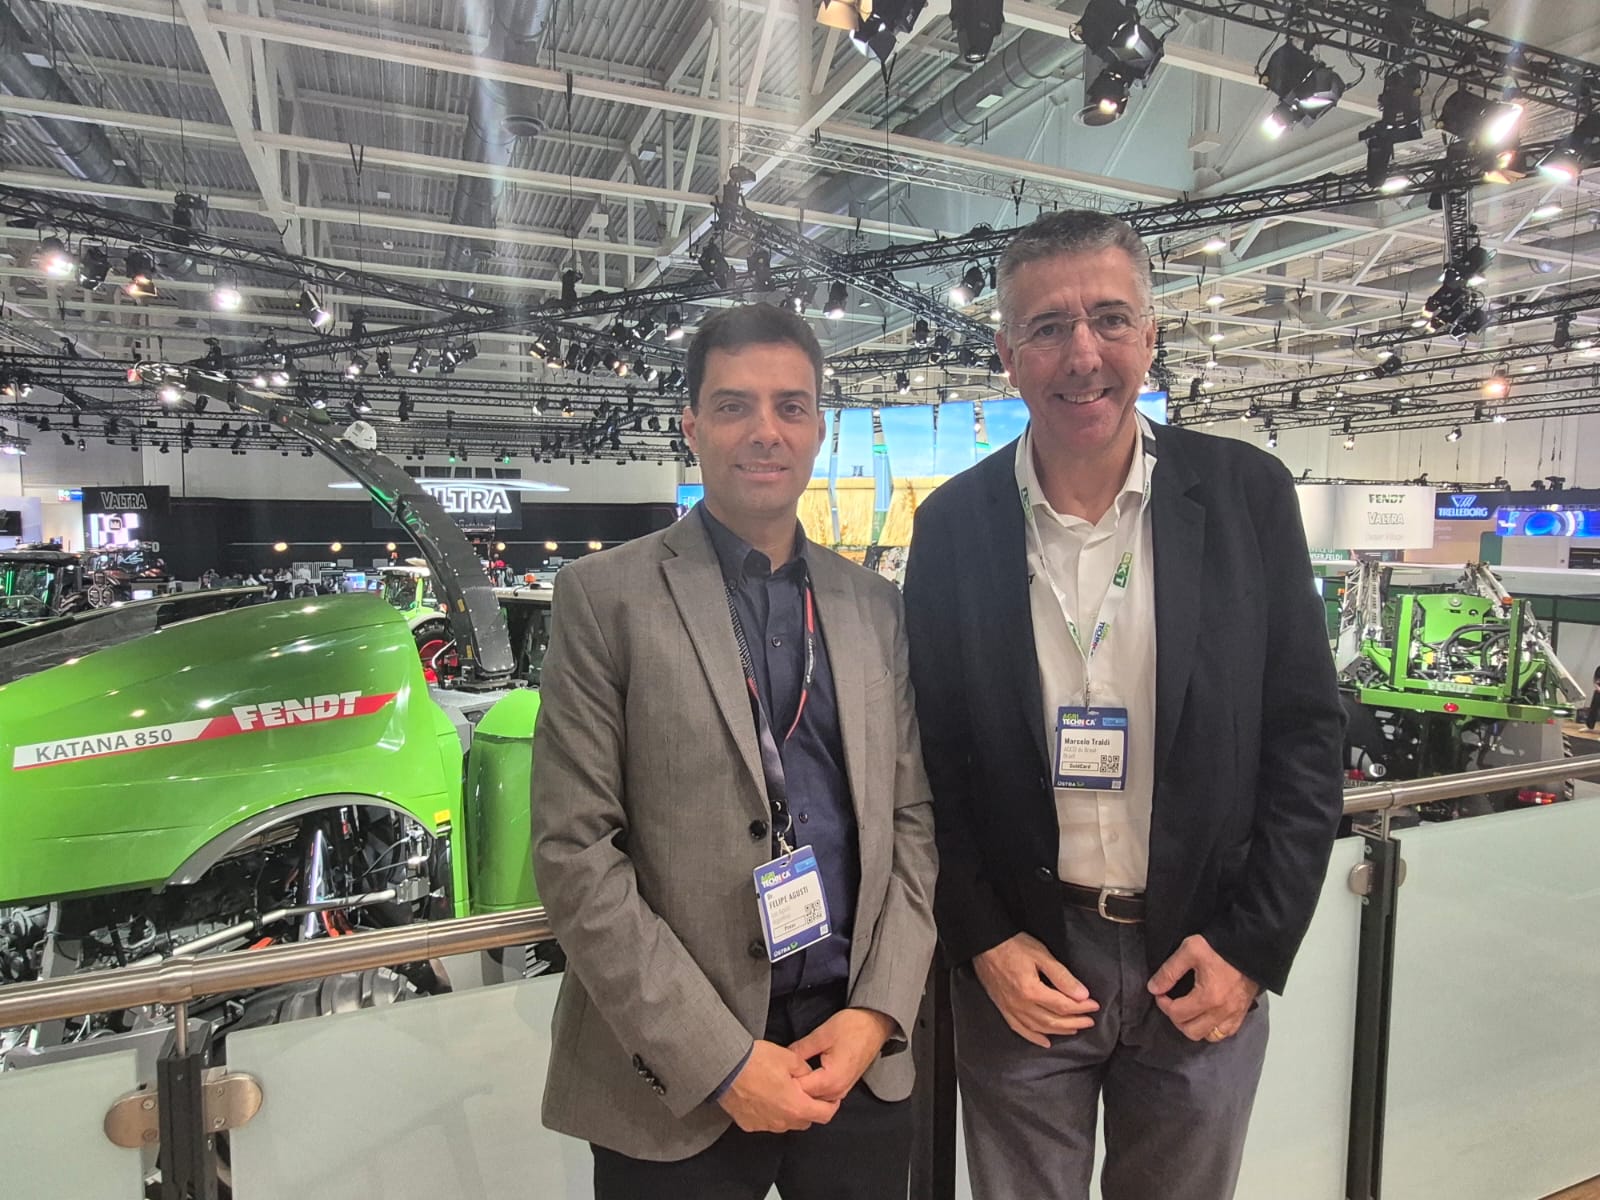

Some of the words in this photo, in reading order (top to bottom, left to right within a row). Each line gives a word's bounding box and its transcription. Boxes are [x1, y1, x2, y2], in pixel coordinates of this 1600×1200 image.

[101, 492, 147, 509] VALTRA
[421, 486, 512, 513] LTRA
[1368, 494, 1405, 503] FENDT
[1367, 512, 1405, 525] VALTRA
[1438, 507, 1488, 517] TRELLEBORG
[232, 691, 362, 731] FENDT
[35, 734, 129, 763] KATANA
[134, 728, 173, 747] 850
[1064, 737, 1090, 745] Marcelo
[1092, 738, 1110, 746] Traldi
[769, 896, 789, 910] FELIPE
[788, 886, 809, 900] AGUSTI
